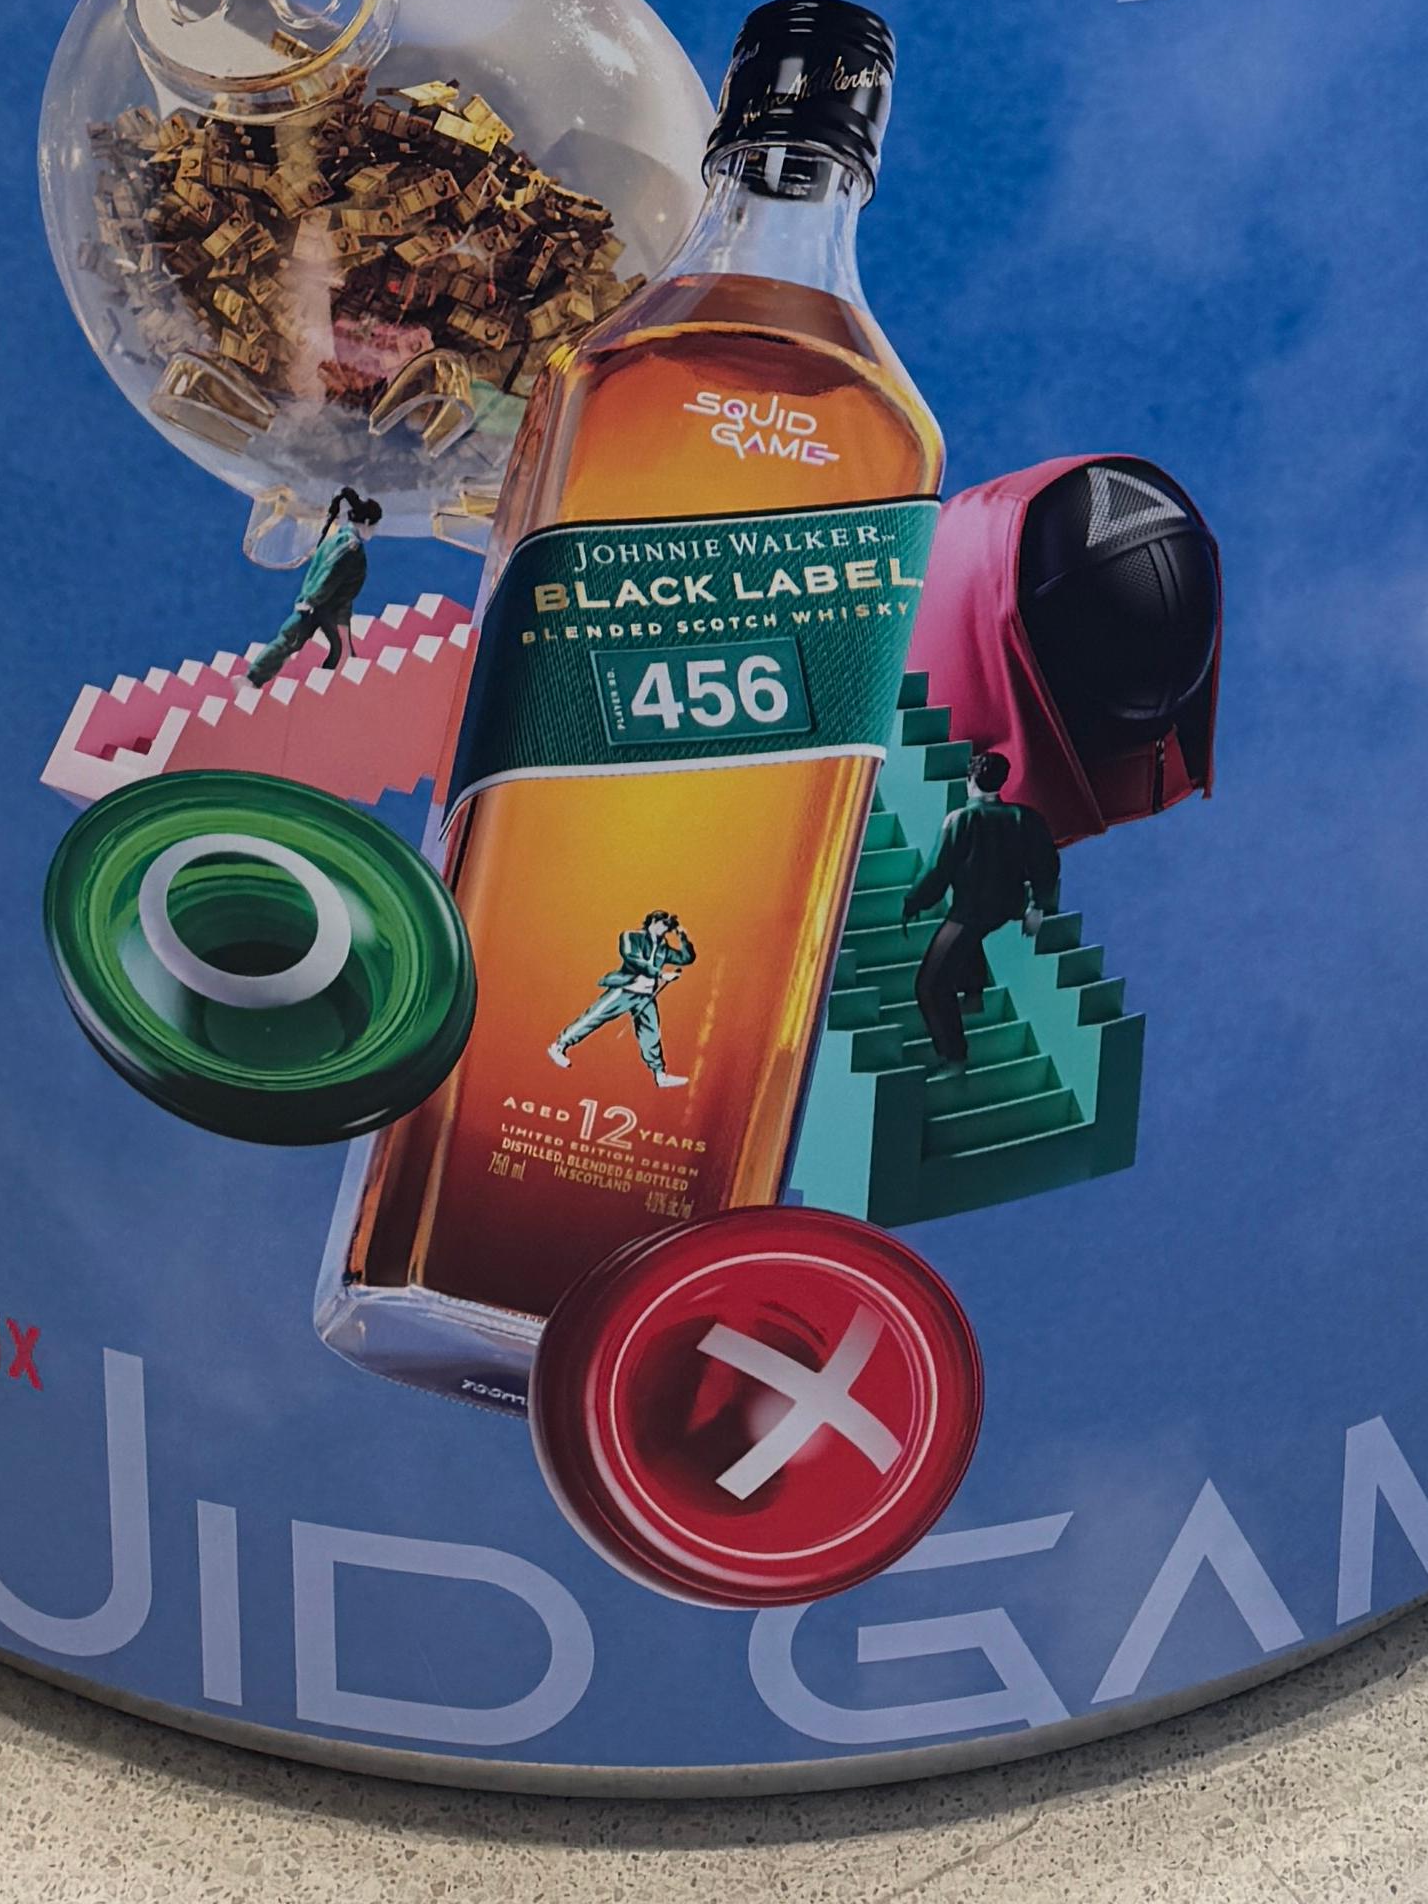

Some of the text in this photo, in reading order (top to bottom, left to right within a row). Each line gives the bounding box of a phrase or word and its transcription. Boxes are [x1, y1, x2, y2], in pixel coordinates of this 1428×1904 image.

[683, 392, 818, 438] SQUID
[711, 421, 840, 466] GAME
[574, 538, 721, 572] JOHNNIE
[534, 558, 923, 614] BLACK LABEL
[522, 601, 911, 644] BLENDED SCOTCH WHISKY
[630, 654, 790, 731] 456
[503, 1096, 706, 1153] AGED 12 YEARS
[501, 1123, 699, 1177] LIMITED EDITION DESIGN
[567, 1154, 621, 1177] BLENDED
[635, 1170, 688, 1192] BOTTLED
[569, 1168, 632, 1193] SCOTLAND
